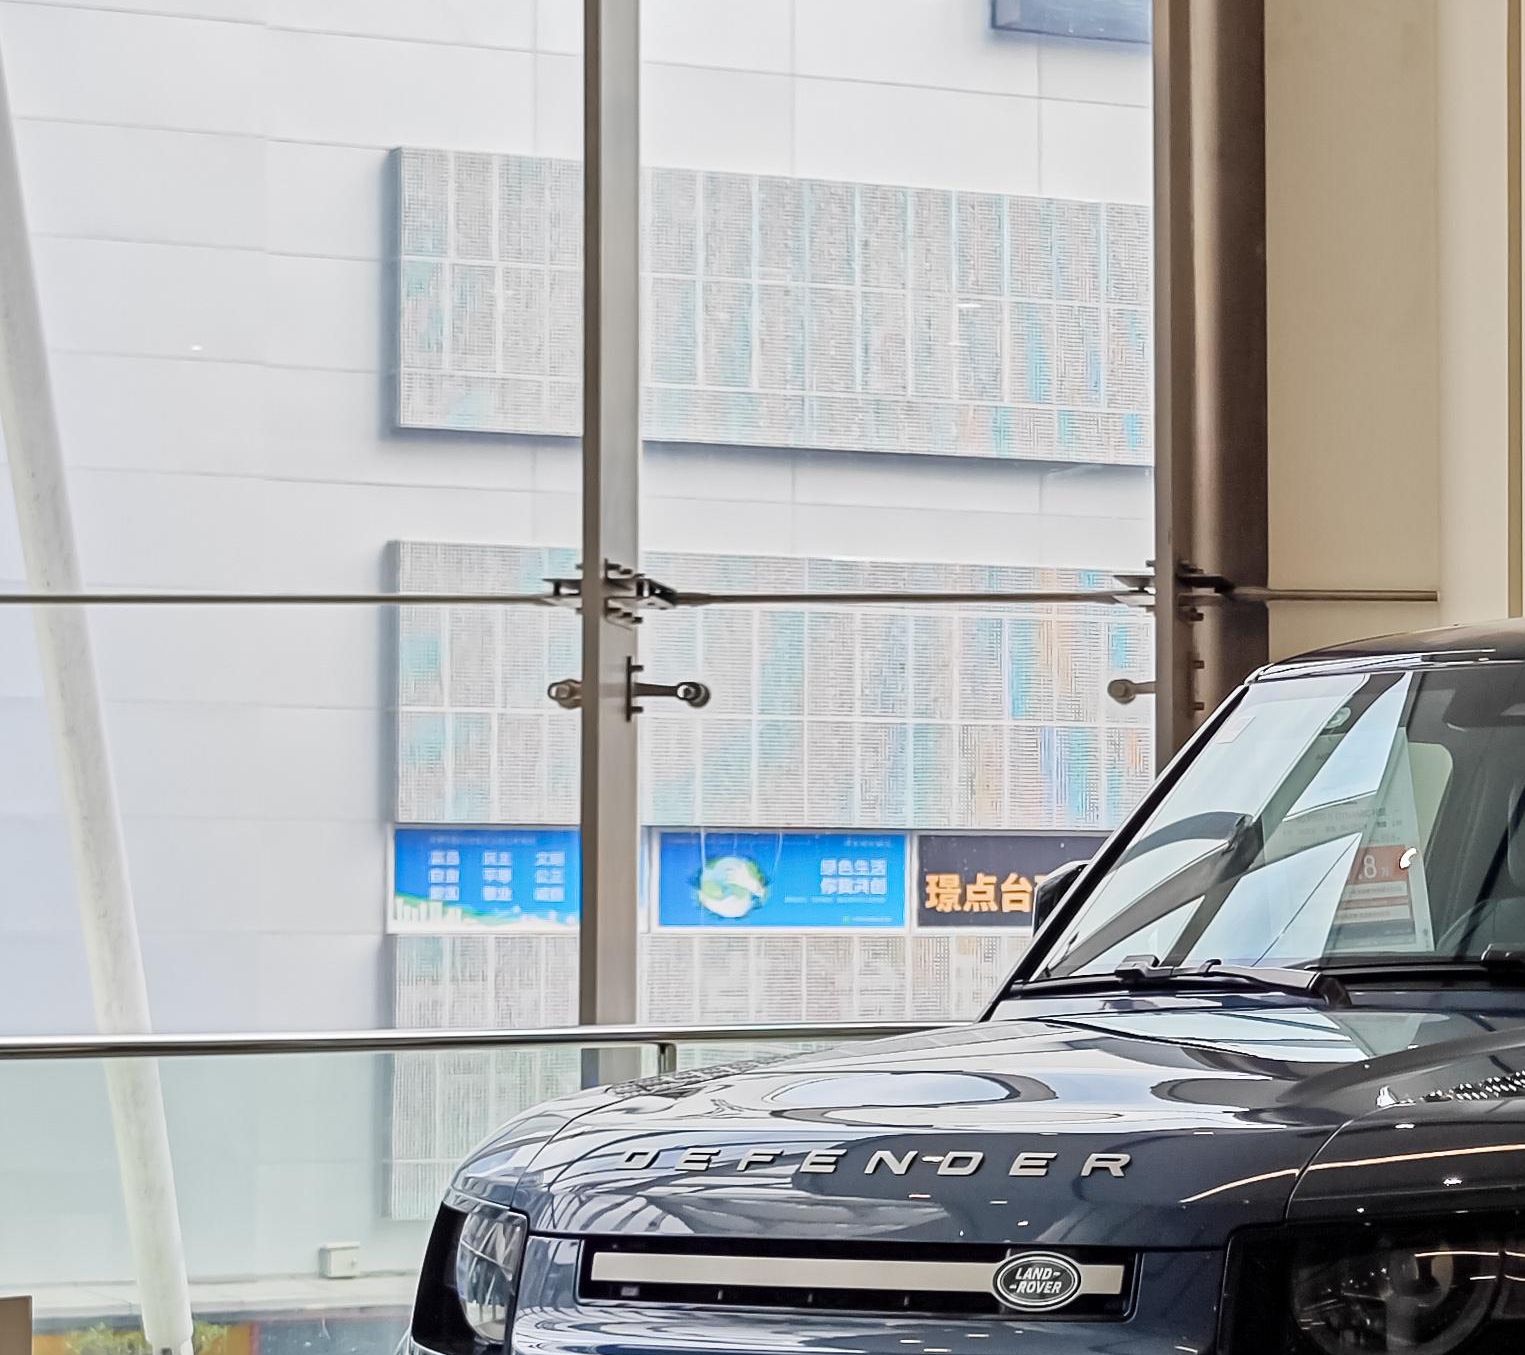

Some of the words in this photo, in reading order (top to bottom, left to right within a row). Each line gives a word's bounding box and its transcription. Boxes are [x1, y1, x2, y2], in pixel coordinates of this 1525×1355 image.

[925, 872, 1050, 913] 璟点台
[616, 1148, 1131, 1177] DEFENDER
